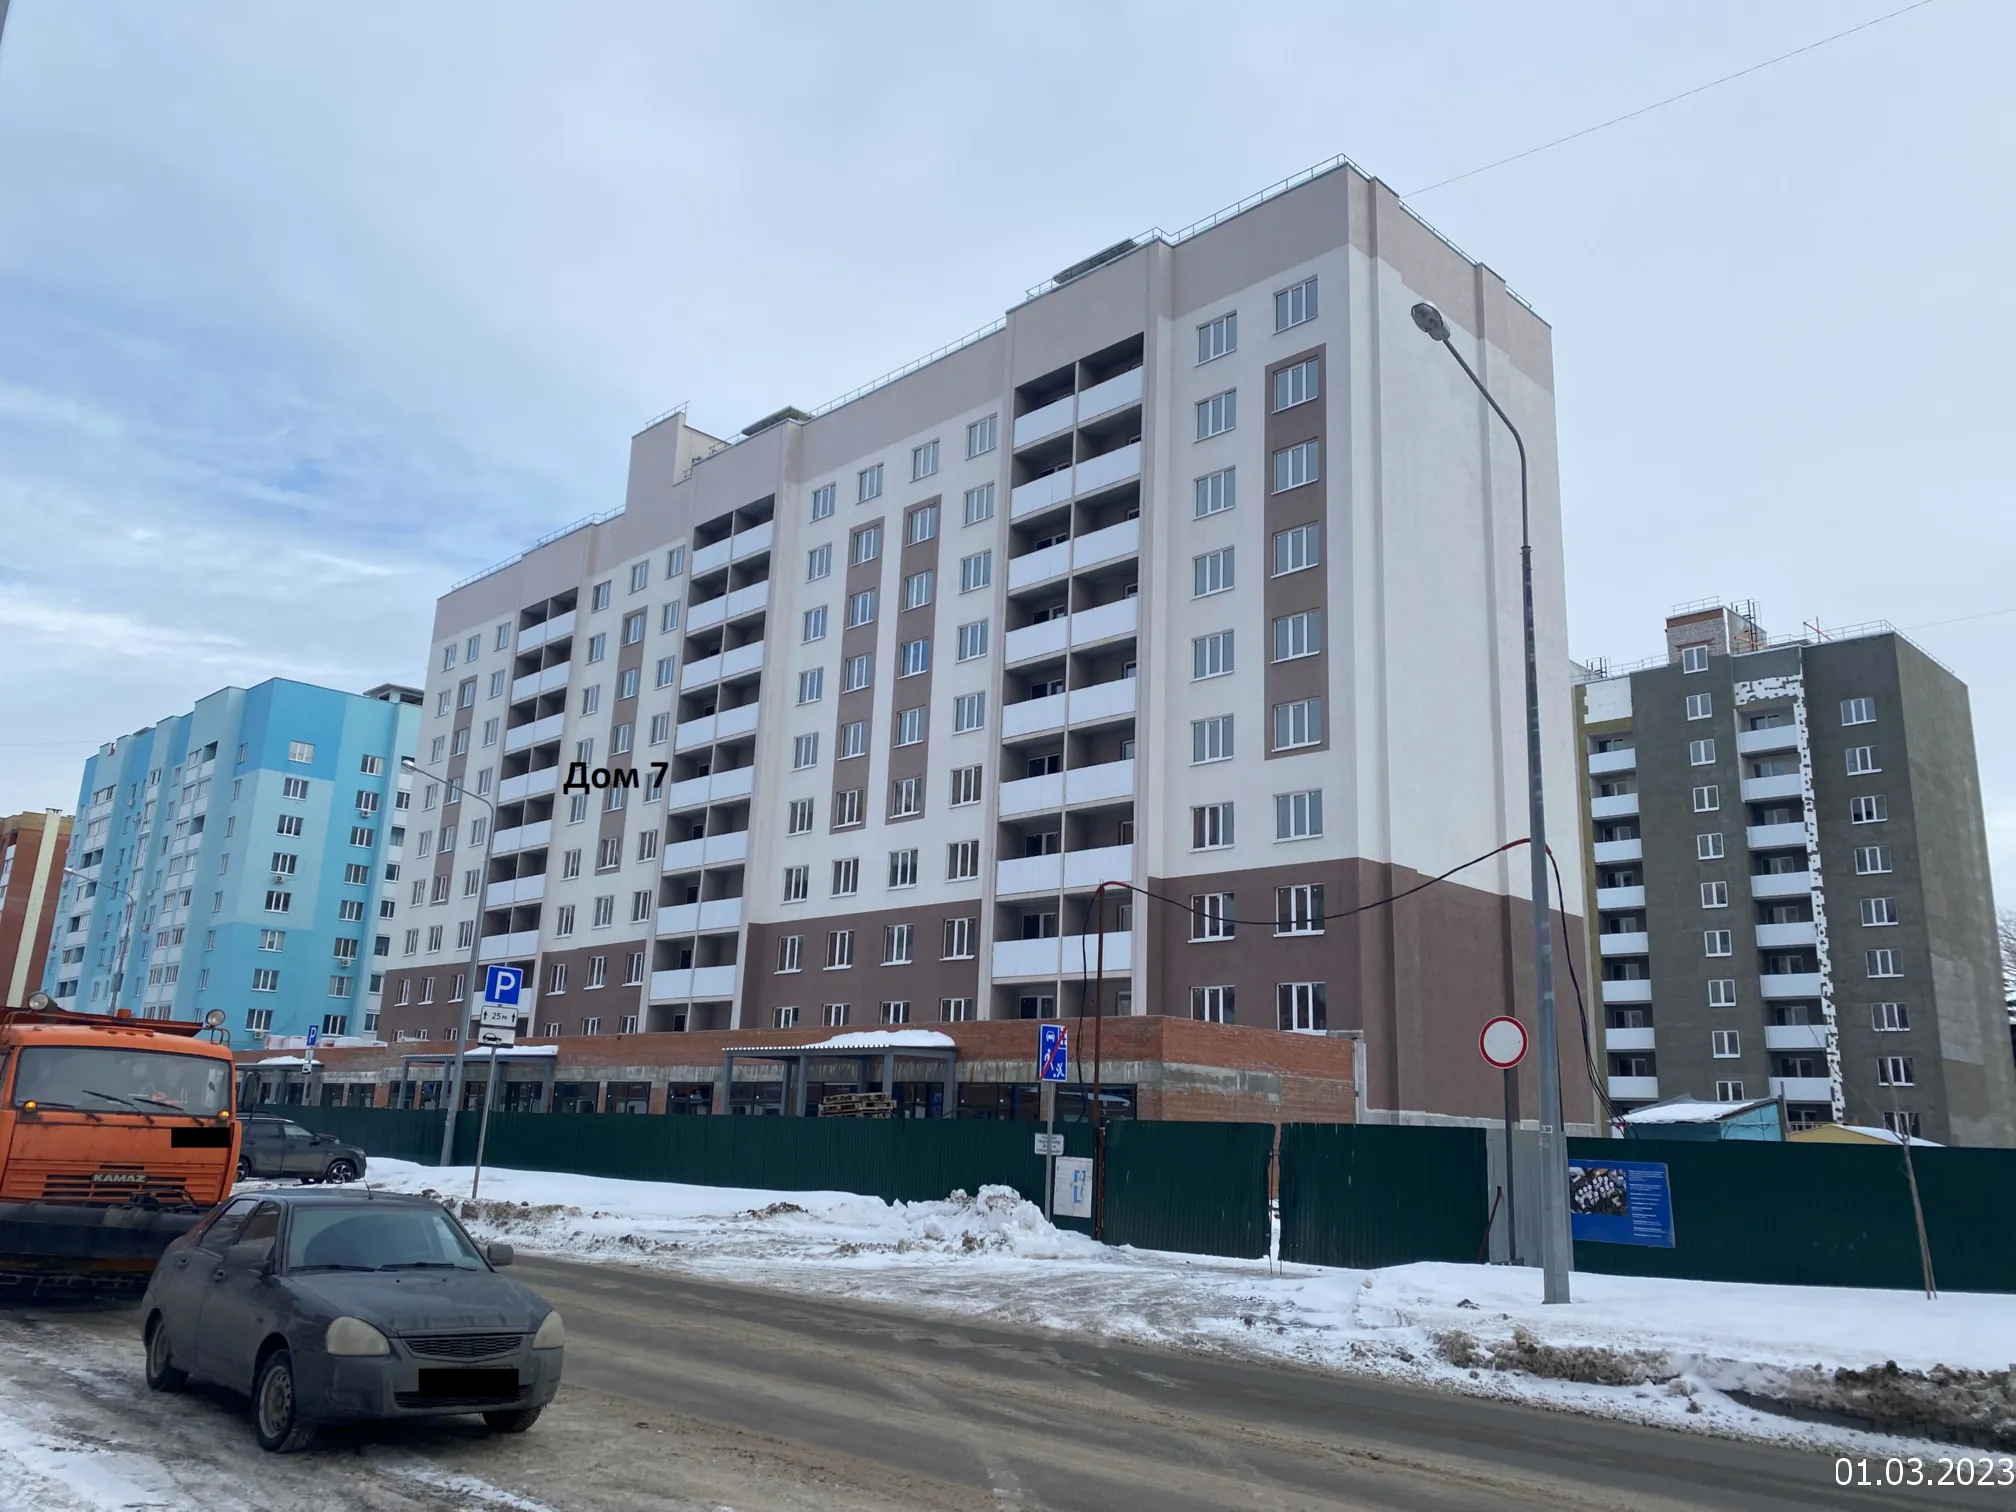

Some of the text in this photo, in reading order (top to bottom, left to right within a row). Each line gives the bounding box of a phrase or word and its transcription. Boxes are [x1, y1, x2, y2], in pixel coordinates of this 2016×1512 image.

[494, 970, 516, 1000] P
[308, 1027, 317, 1044] P
[92, 1173, 147, 1183] KAMAZ
